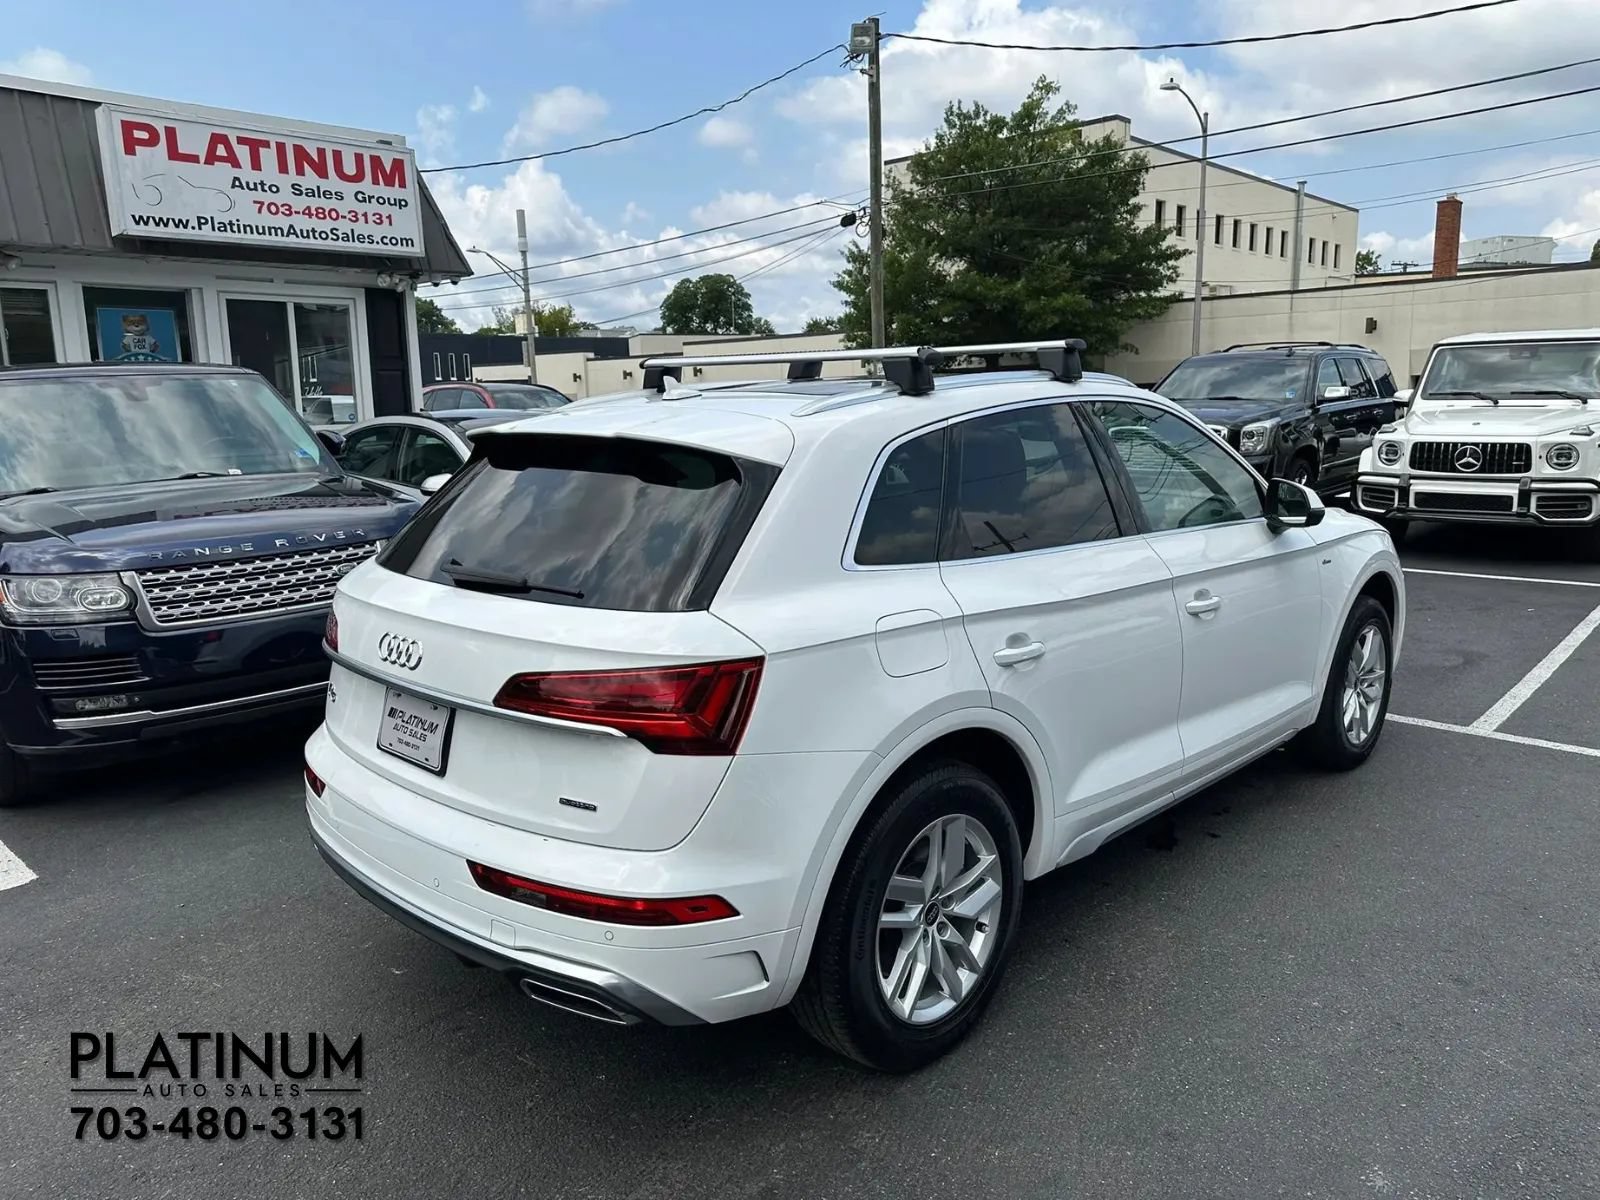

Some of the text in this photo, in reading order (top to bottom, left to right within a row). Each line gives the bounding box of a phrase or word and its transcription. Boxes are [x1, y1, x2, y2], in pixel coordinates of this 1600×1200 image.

[120, 119, 408, 189] PLATINUM
[230, 176, 409, 210] Auto Sales Group
[252, 200, 394, 226] 703-480-3131
[131, 214, 415, 248] www.PlatinumAutoSales.com
[150, 528, 368, 560] RANGE ROVER
[393, 722, 428, 742] AUTO SALES
[395, 709, 439, 735] PLATINUM
